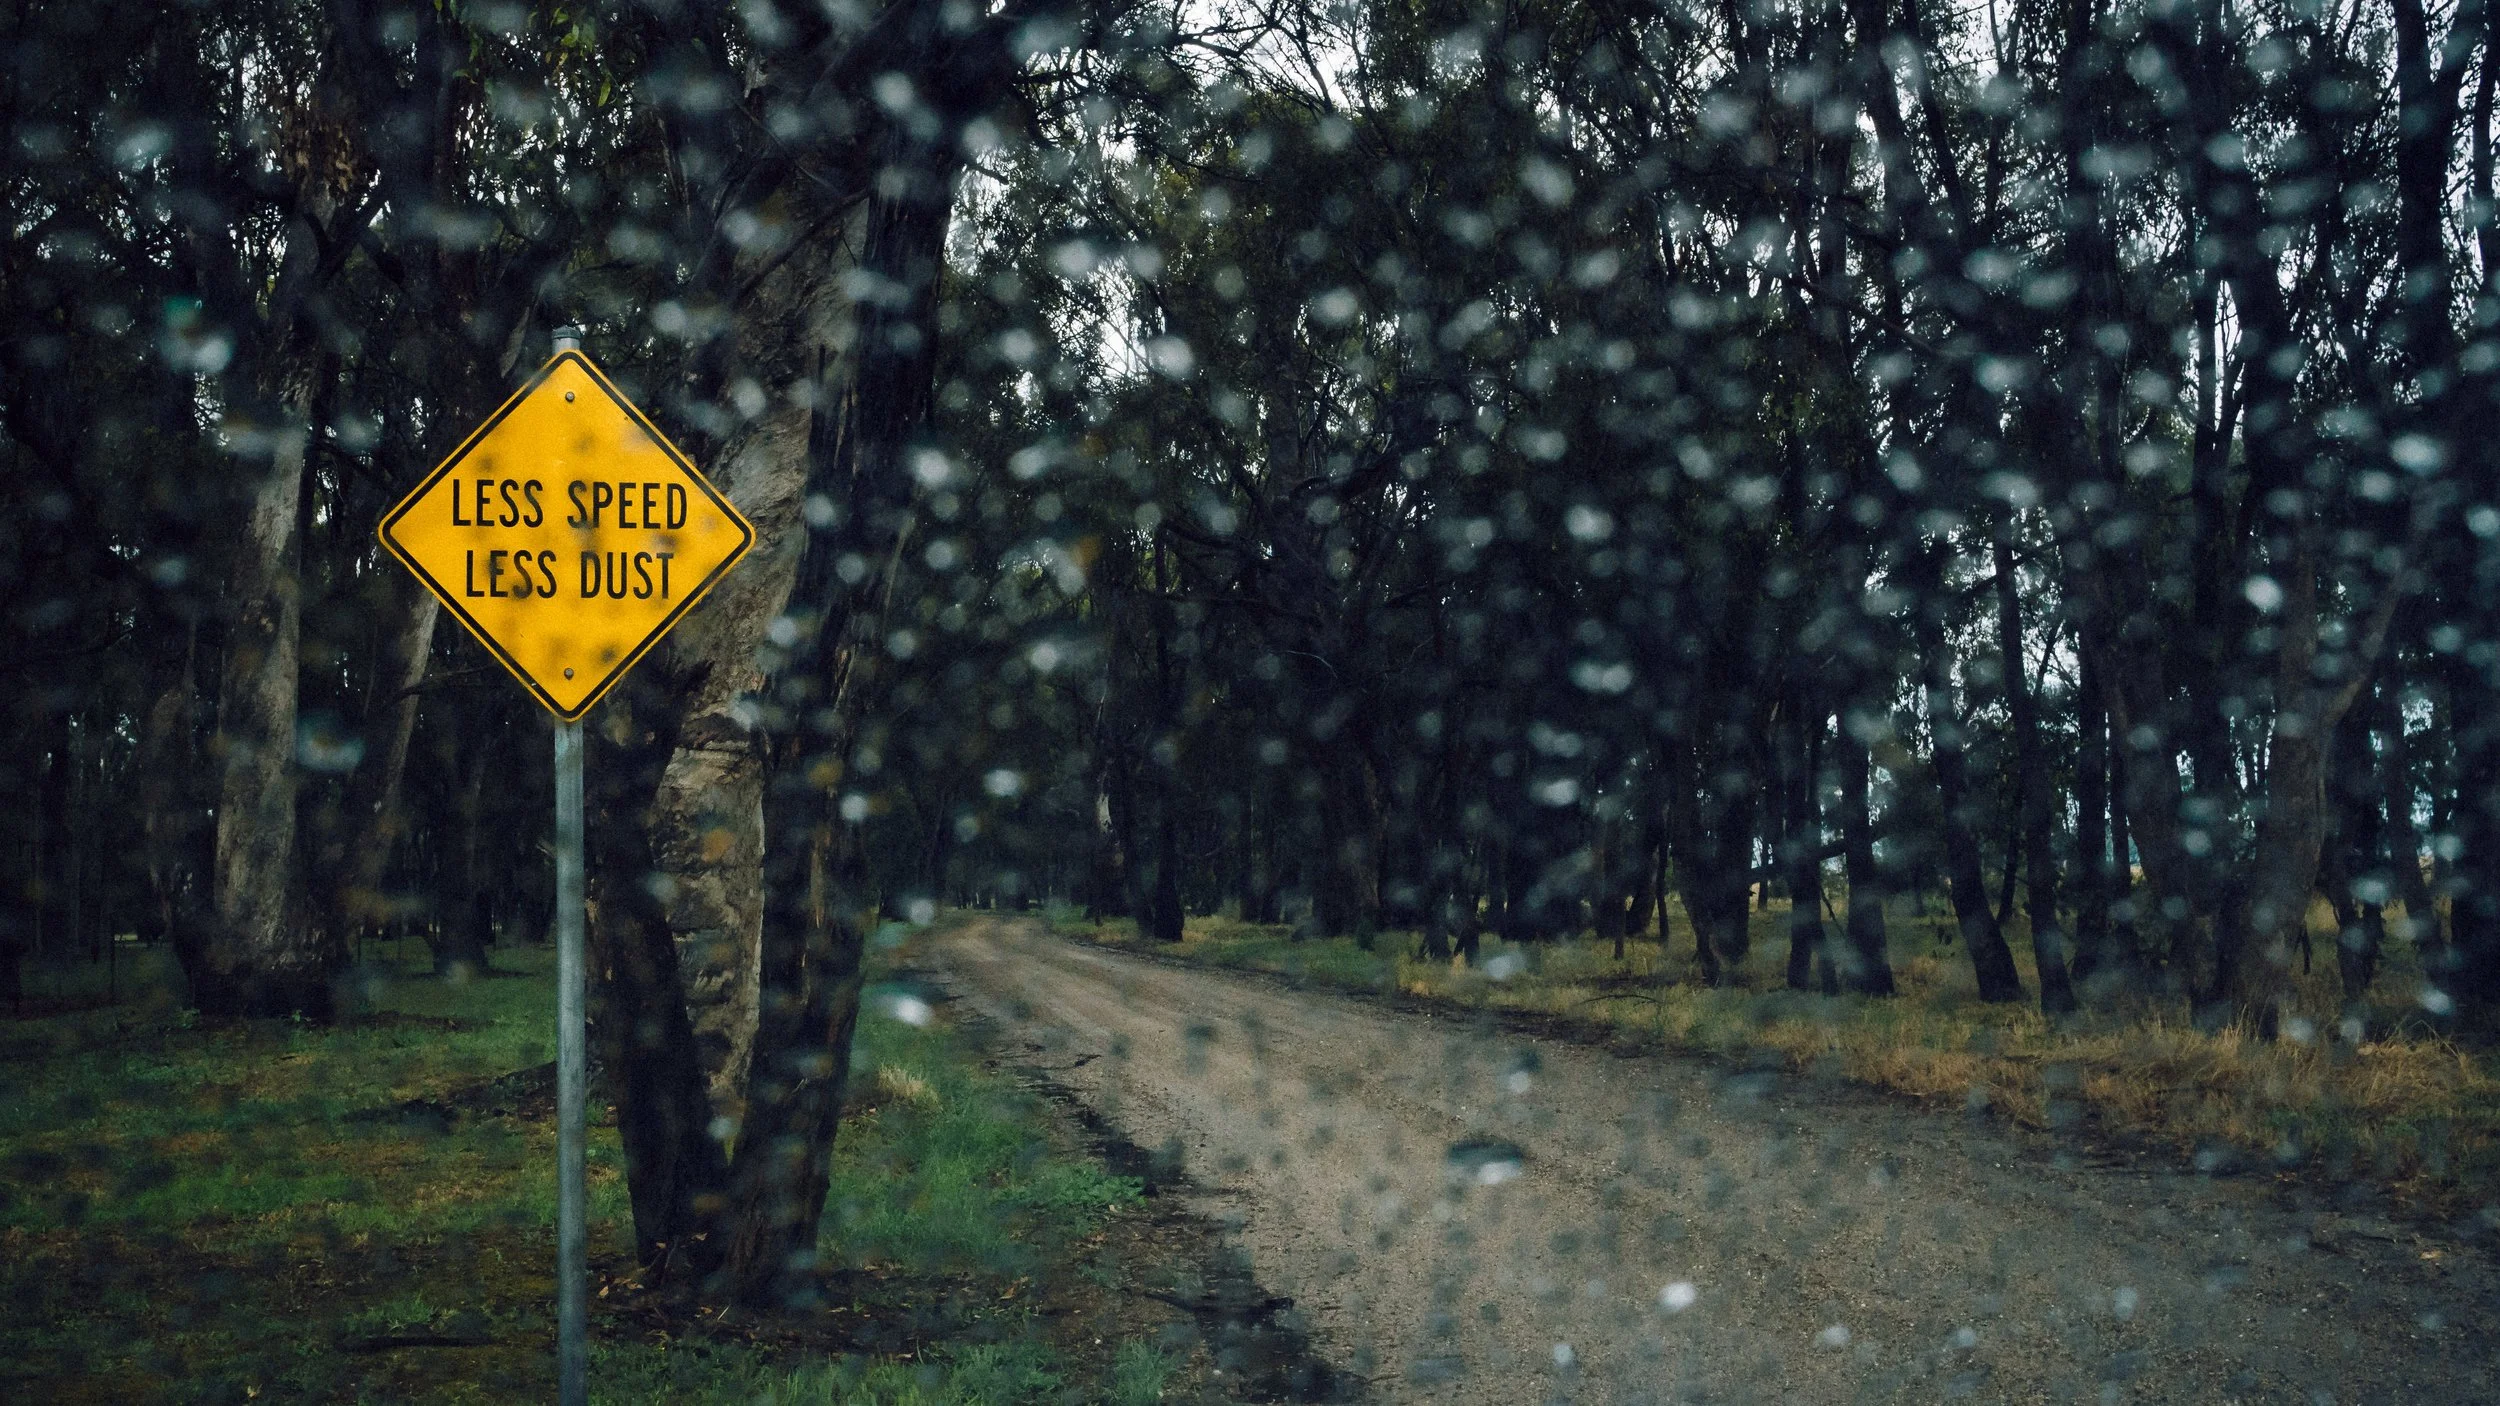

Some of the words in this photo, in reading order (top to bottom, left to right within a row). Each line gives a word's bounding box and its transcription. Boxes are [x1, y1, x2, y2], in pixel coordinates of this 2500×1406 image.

[452, 479, 544, 528] LESS
[567, 480, 688, 530] SPEED
[465, 549, 557, 599] LESS
[580, 551, 675, 600] DUST
